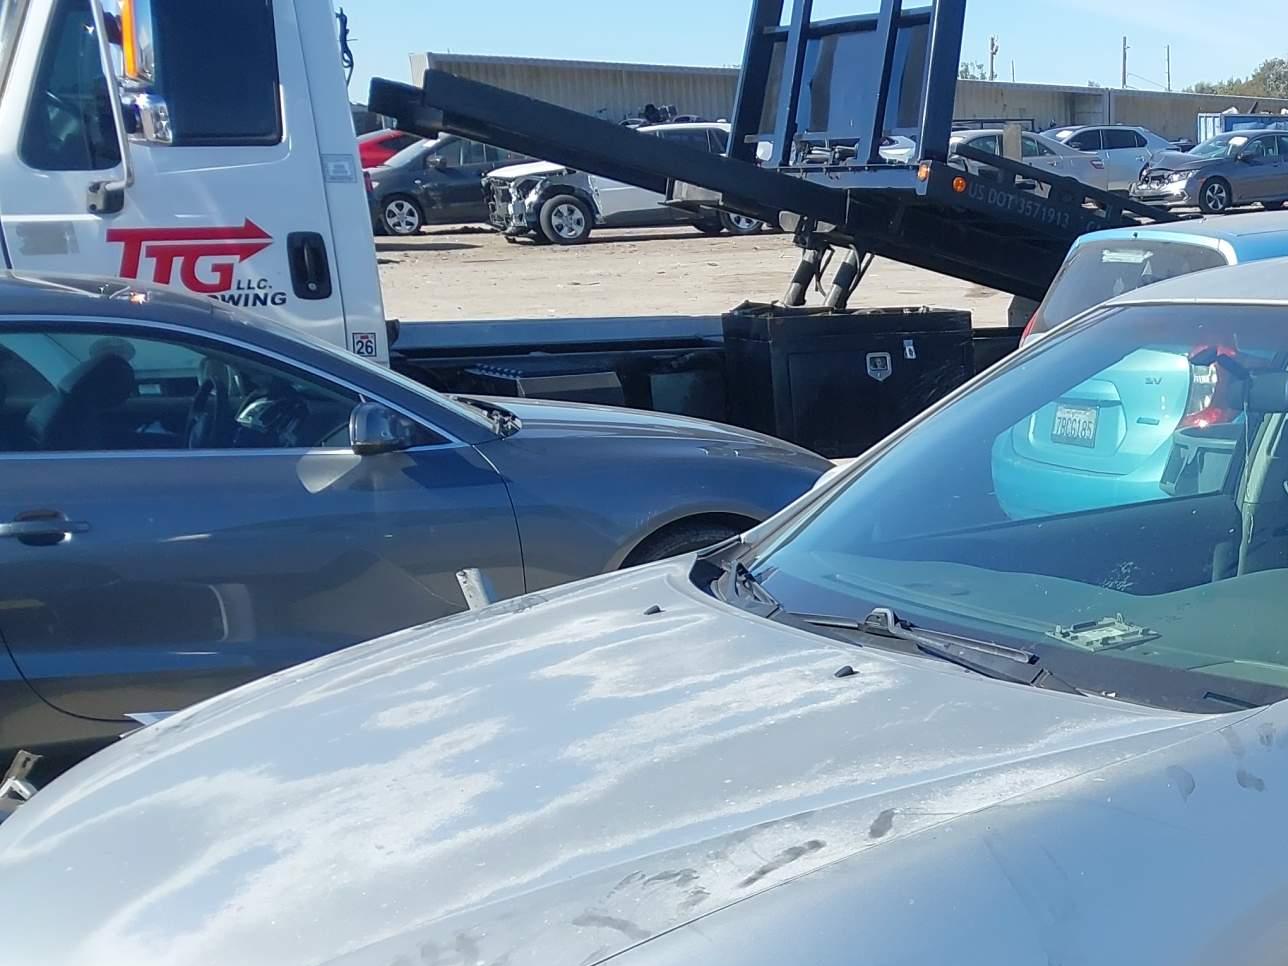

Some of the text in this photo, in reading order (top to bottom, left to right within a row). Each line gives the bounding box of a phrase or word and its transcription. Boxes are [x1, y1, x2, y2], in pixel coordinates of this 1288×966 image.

[969, 183, 985, 200] US
[988, 191, 1014, 209] DOT
[106, 219, 272, 294] TTG
[237, 279, 272, 291] LLC.
[356, 340, 374, 355] 26
